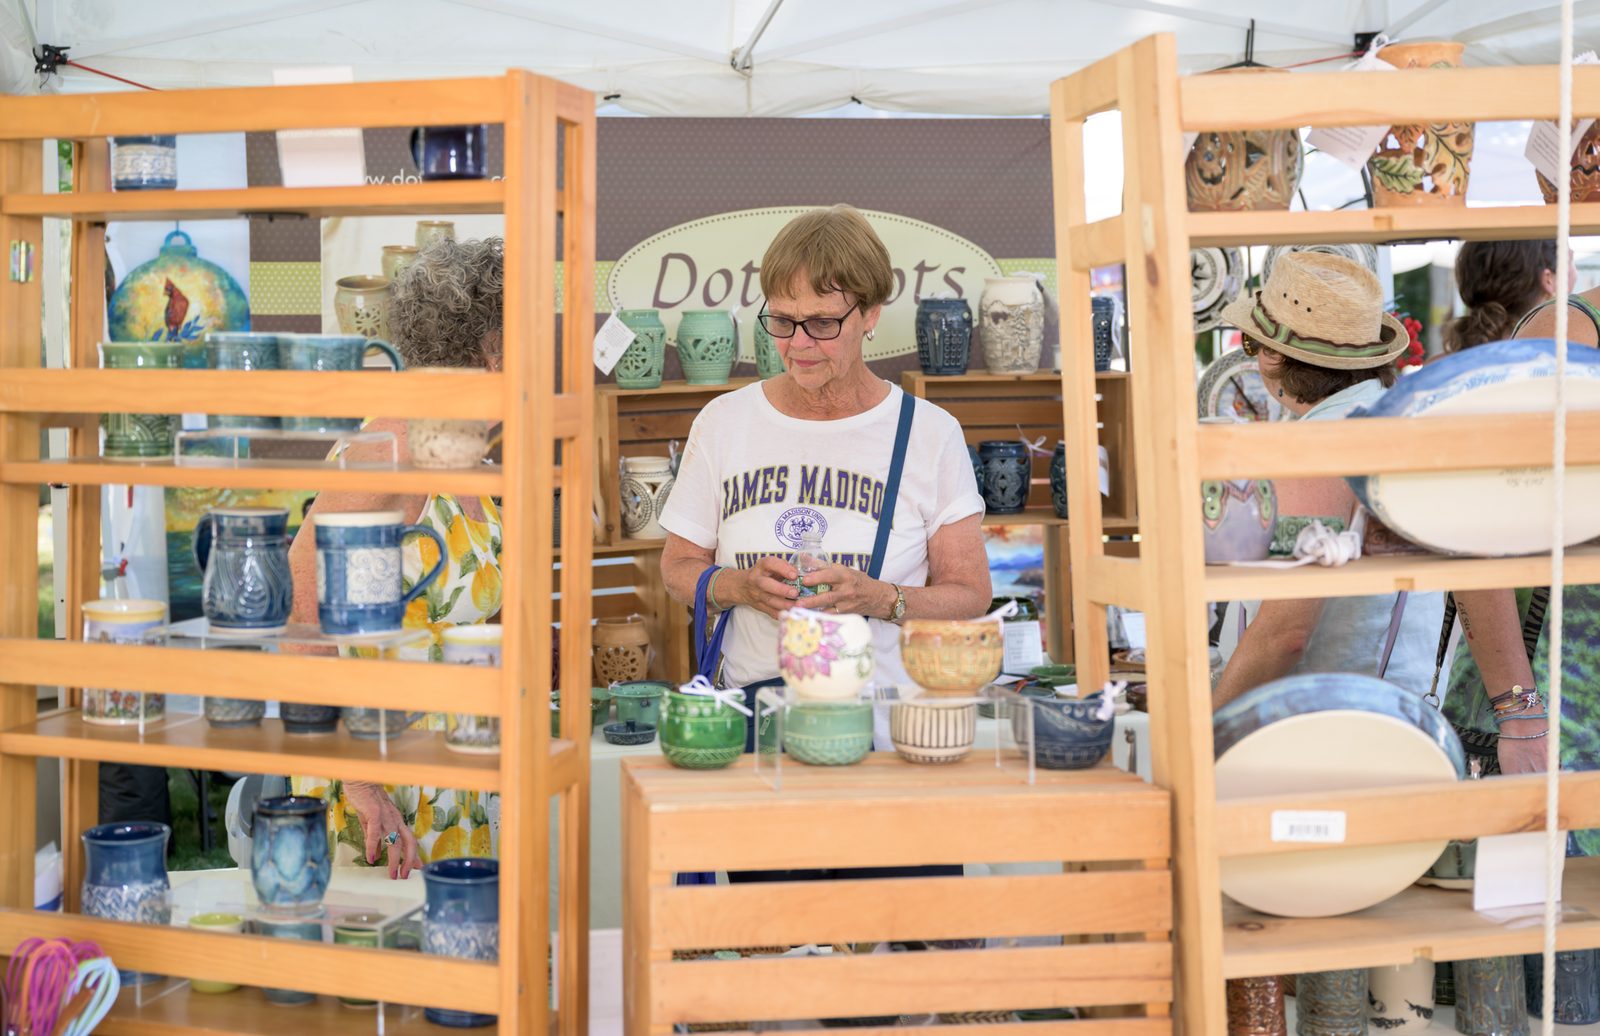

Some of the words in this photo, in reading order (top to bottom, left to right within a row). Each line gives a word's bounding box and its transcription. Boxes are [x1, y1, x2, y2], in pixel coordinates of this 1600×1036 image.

[882, 260, 966, 306] ots
[722, 465, 789, 521] JAMES
[798, 464, 888, 524] MADISO
[782, 509, 811, 520] MADISON
